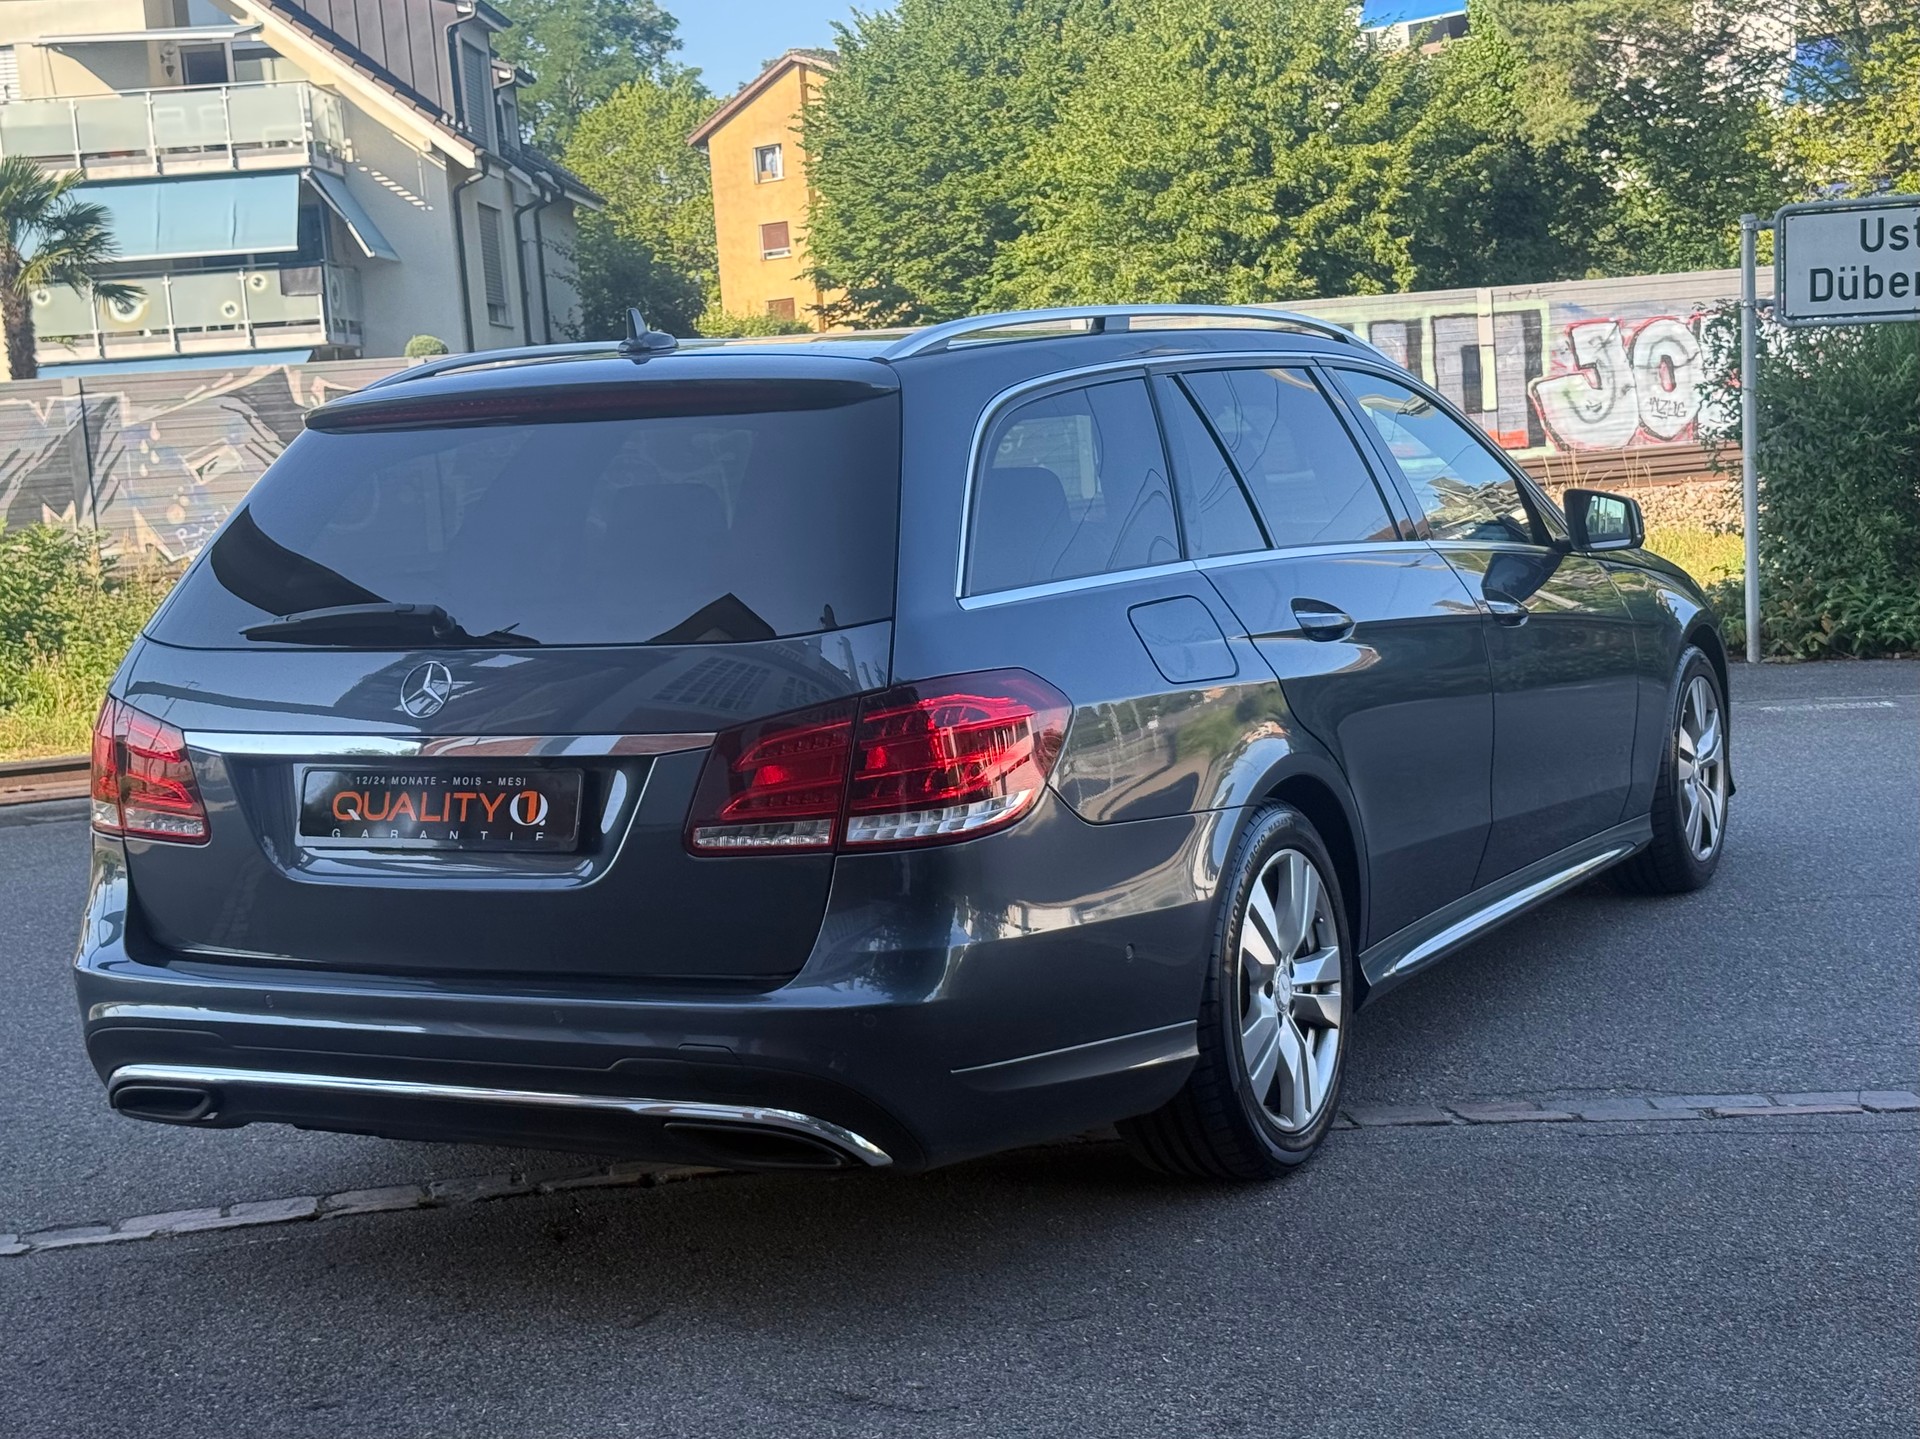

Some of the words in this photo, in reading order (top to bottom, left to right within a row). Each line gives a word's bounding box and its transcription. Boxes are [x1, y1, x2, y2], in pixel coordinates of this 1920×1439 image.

[356, 776, 386, 785] 12/24
[391, 776, 437, 786] MONATE
[452, 776, 482, 786] MOIS
[497, 777, 527, 786] MESI
[332, 790, 507, 823] QUALITY
[1244, 834, 1266, 874] macro
